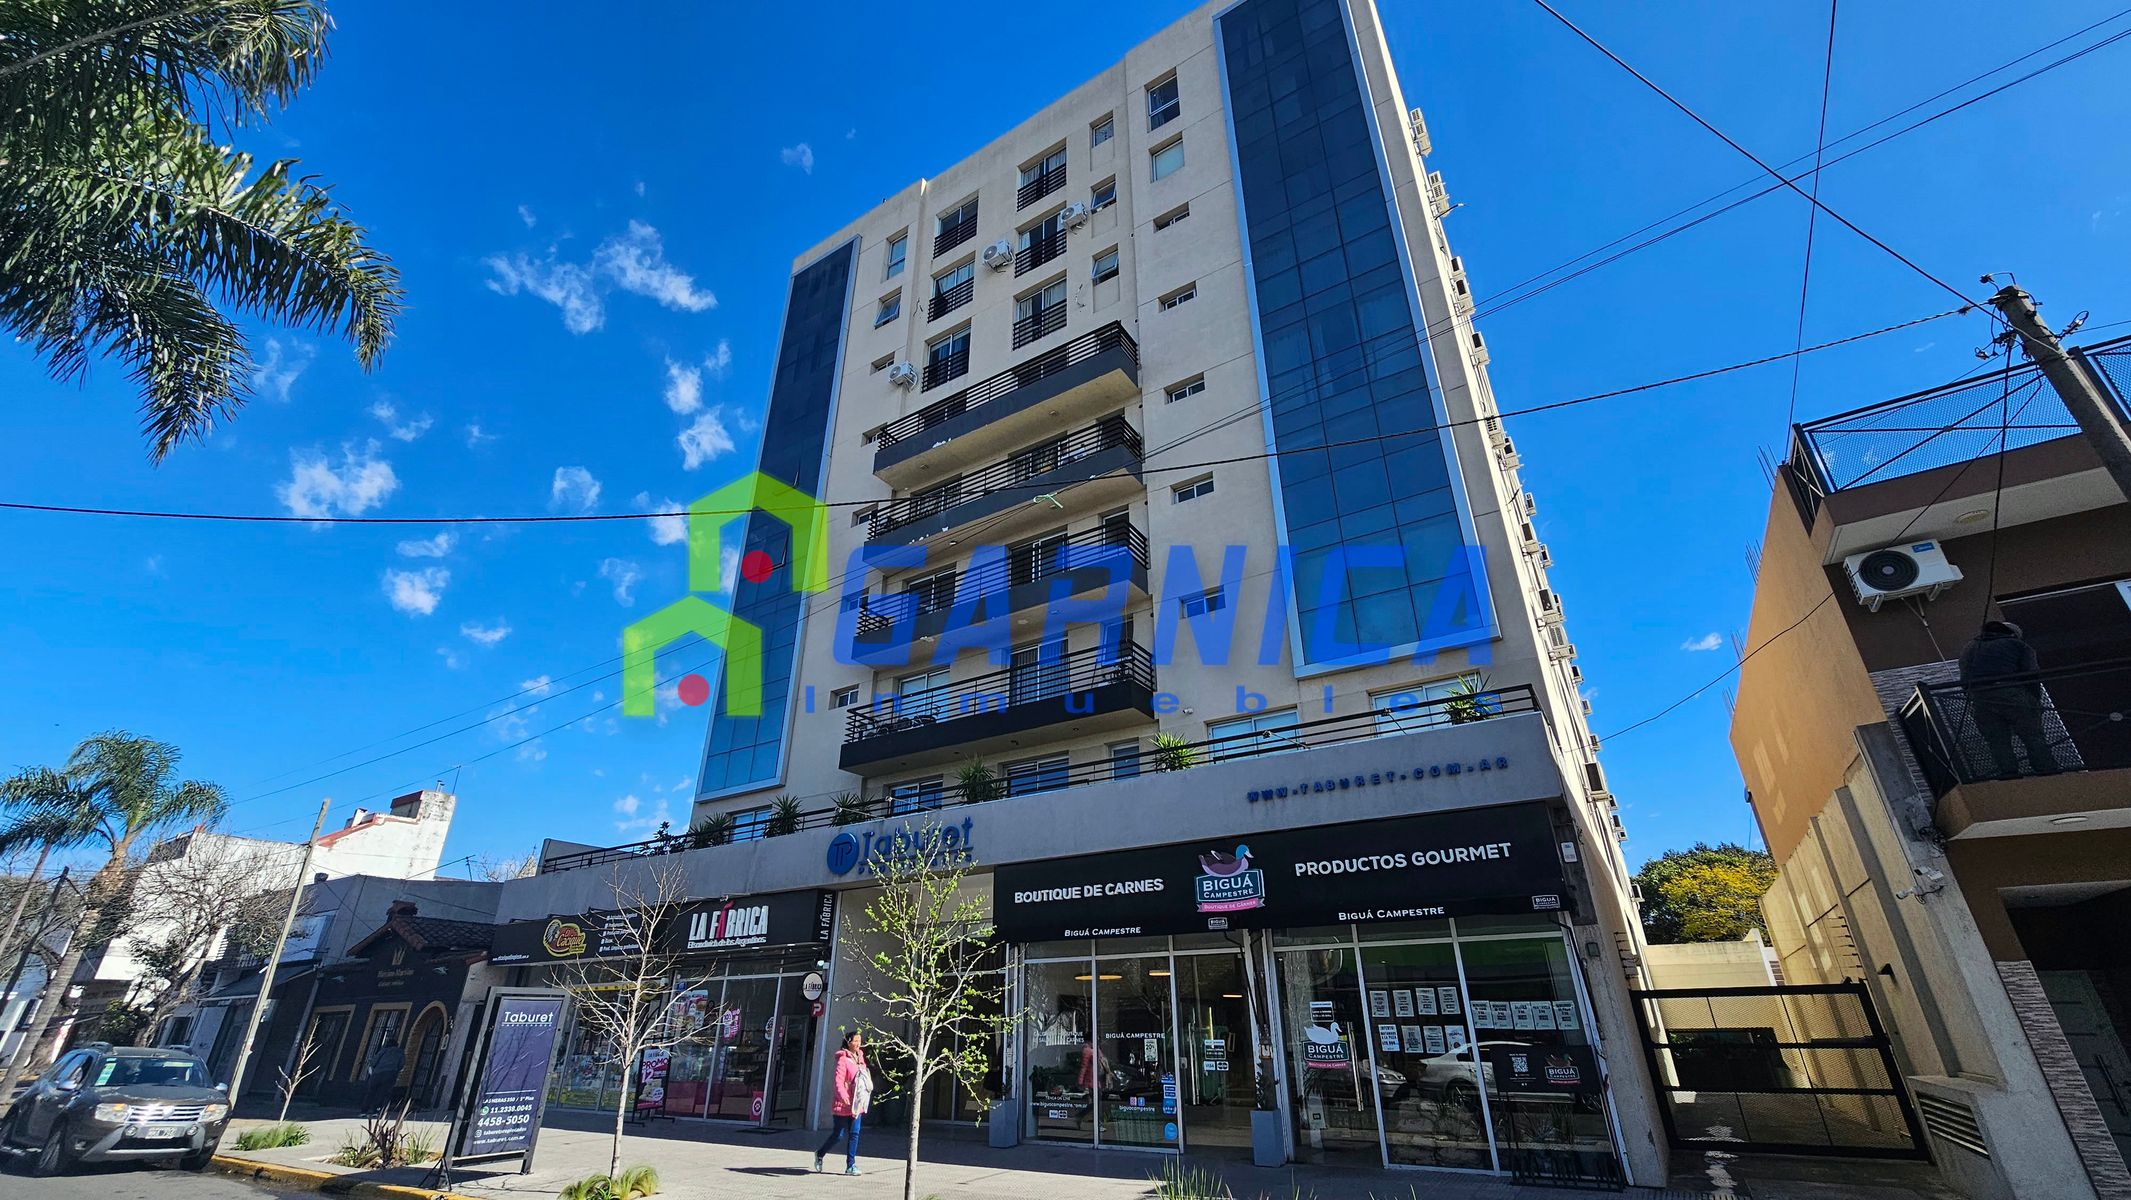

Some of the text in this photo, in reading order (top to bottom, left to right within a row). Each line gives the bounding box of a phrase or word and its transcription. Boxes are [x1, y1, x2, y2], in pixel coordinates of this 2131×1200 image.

[1295, 842, 1511, 876] PRODUCTOS GOURMET
[1203, 873, 1254, 891] BIGUÁ
[1014, 878, 1164, 903] BOUTIQUE DE CARNES
[1203, 888, 1254, 899] CAMPESTRE
[1339, 906, 1445, 922] BIGUÁ CAMPESTRE
[689, 901, 769, 941] LA FÁBRICA
[820, 932, 829, 940] LA
[1064, 927, 1141, 937] BIGUÁ CAMPESTRE
[504, 1011, 553, 1023] Taburet
[1307, 1044, 1344, 1054] BIGUÁ
[477, 1114, 530, 1127] 4458-5050
